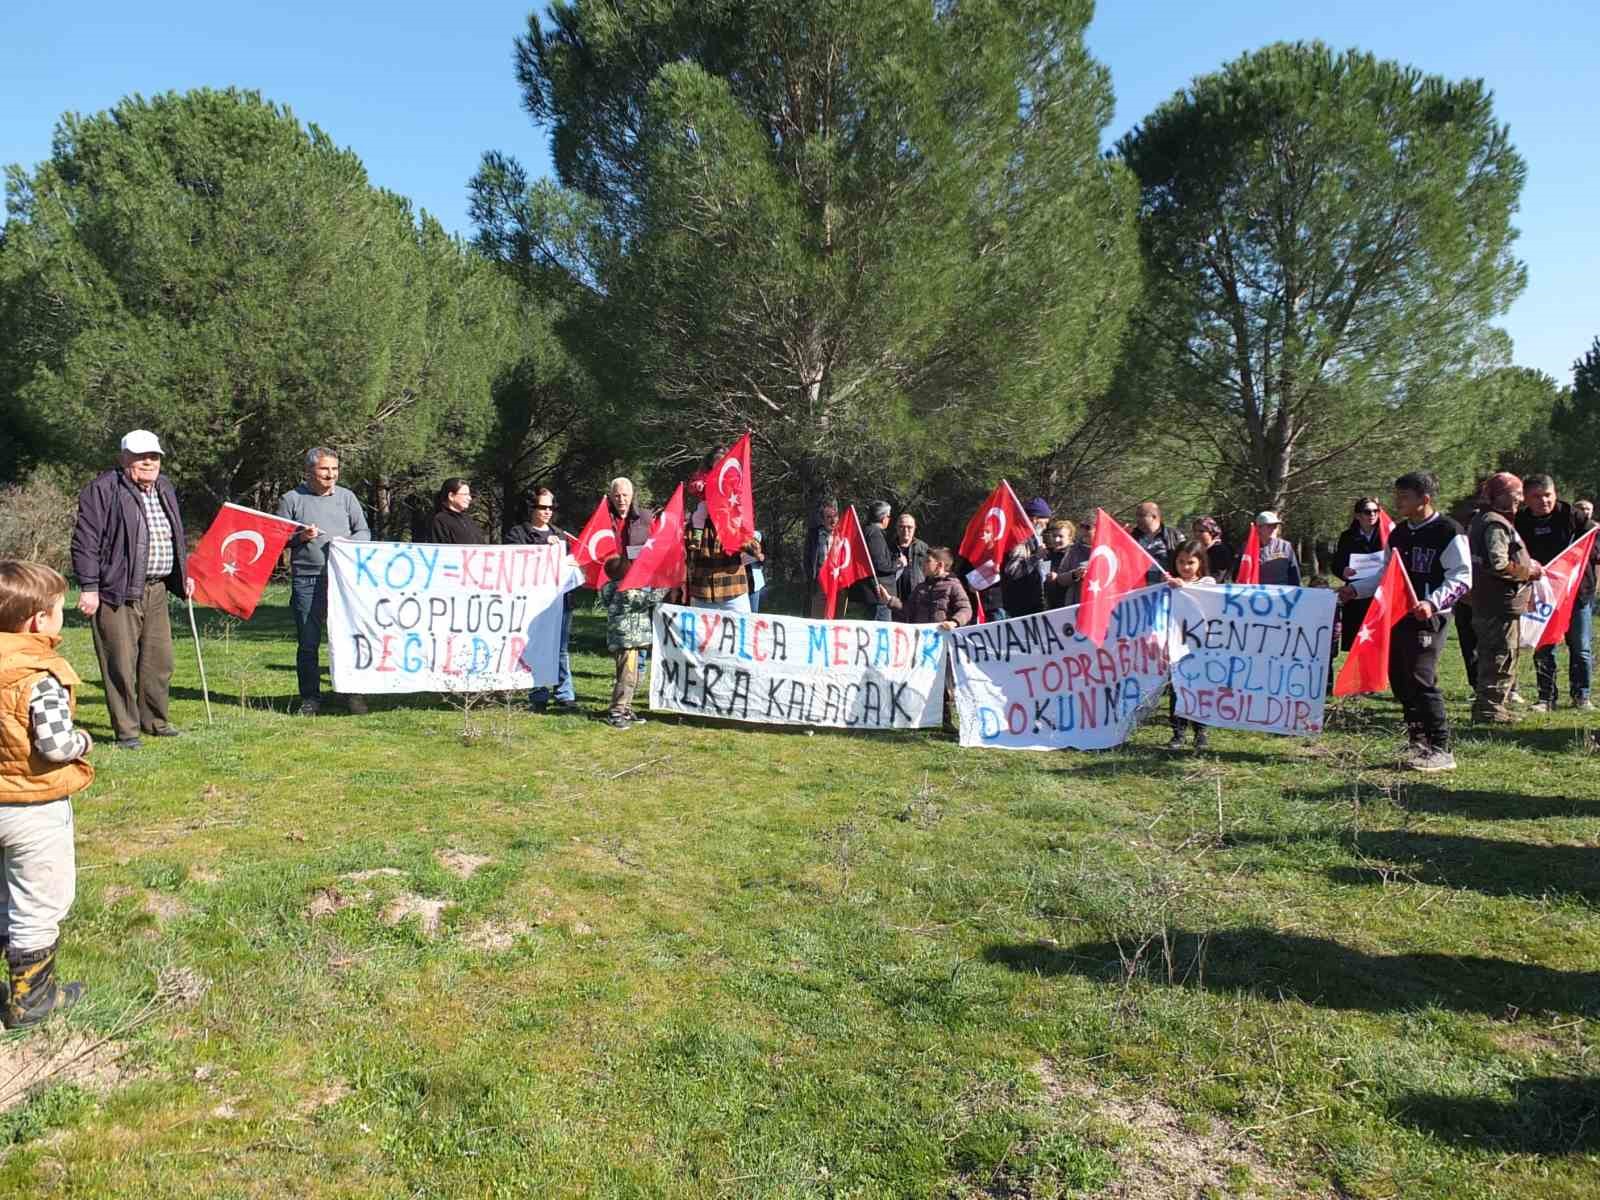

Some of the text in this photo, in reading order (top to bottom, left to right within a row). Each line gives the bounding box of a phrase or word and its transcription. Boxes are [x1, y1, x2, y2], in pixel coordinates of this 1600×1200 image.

[375, 592, 527, 633] ÇÖPLÜĞÜ
[1222, 583, 1303, 619] KÖY
[352, 632, 532, 676] DEĞİLDİR
[661, 610, 944, 672] KAYALCA MERADIR
[1181, 618, 1329, 659] KENTİN
[660, 658, 914, 726] MERA KALACAK
[1178, 652, 1324, 700] ÇÖPLÜĞÜ
